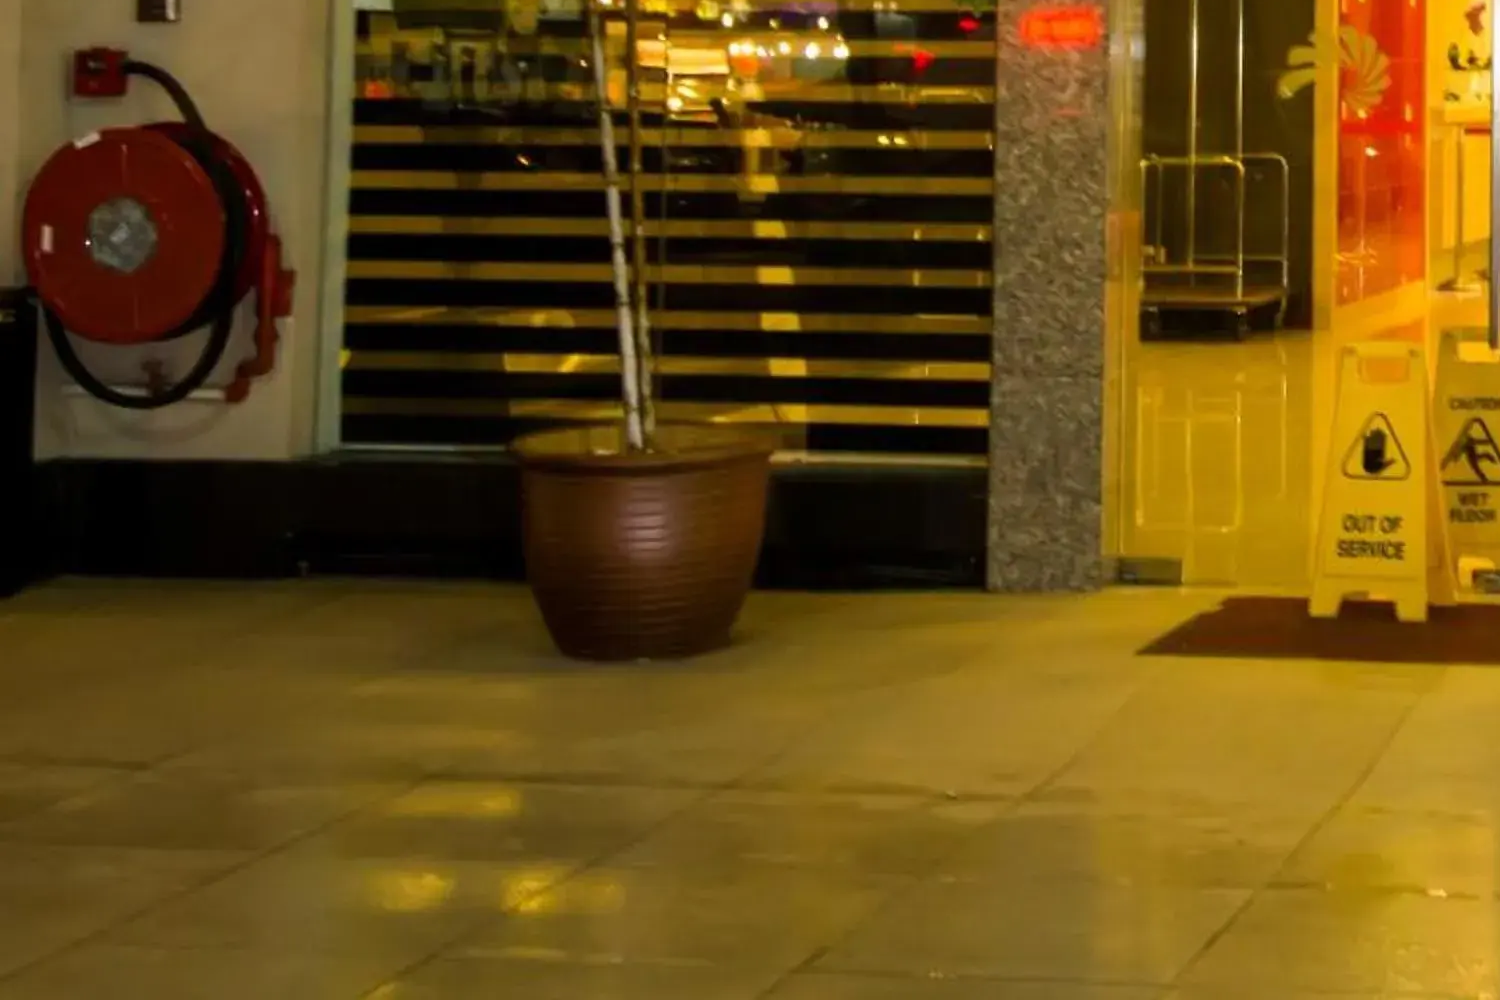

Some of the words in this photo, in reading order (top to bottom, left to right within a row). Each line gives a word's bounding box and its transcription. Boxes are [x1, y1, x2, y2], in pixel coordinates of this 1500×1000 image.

[1458, 492, 1488, 506] WET
[1343, 513, 1376, 533] OUT
[1380, 515, 1404, 534] OF
[1449, 507, 1496, 522] FLOOR
[1337, 539, 1405, 560] SERVICE
